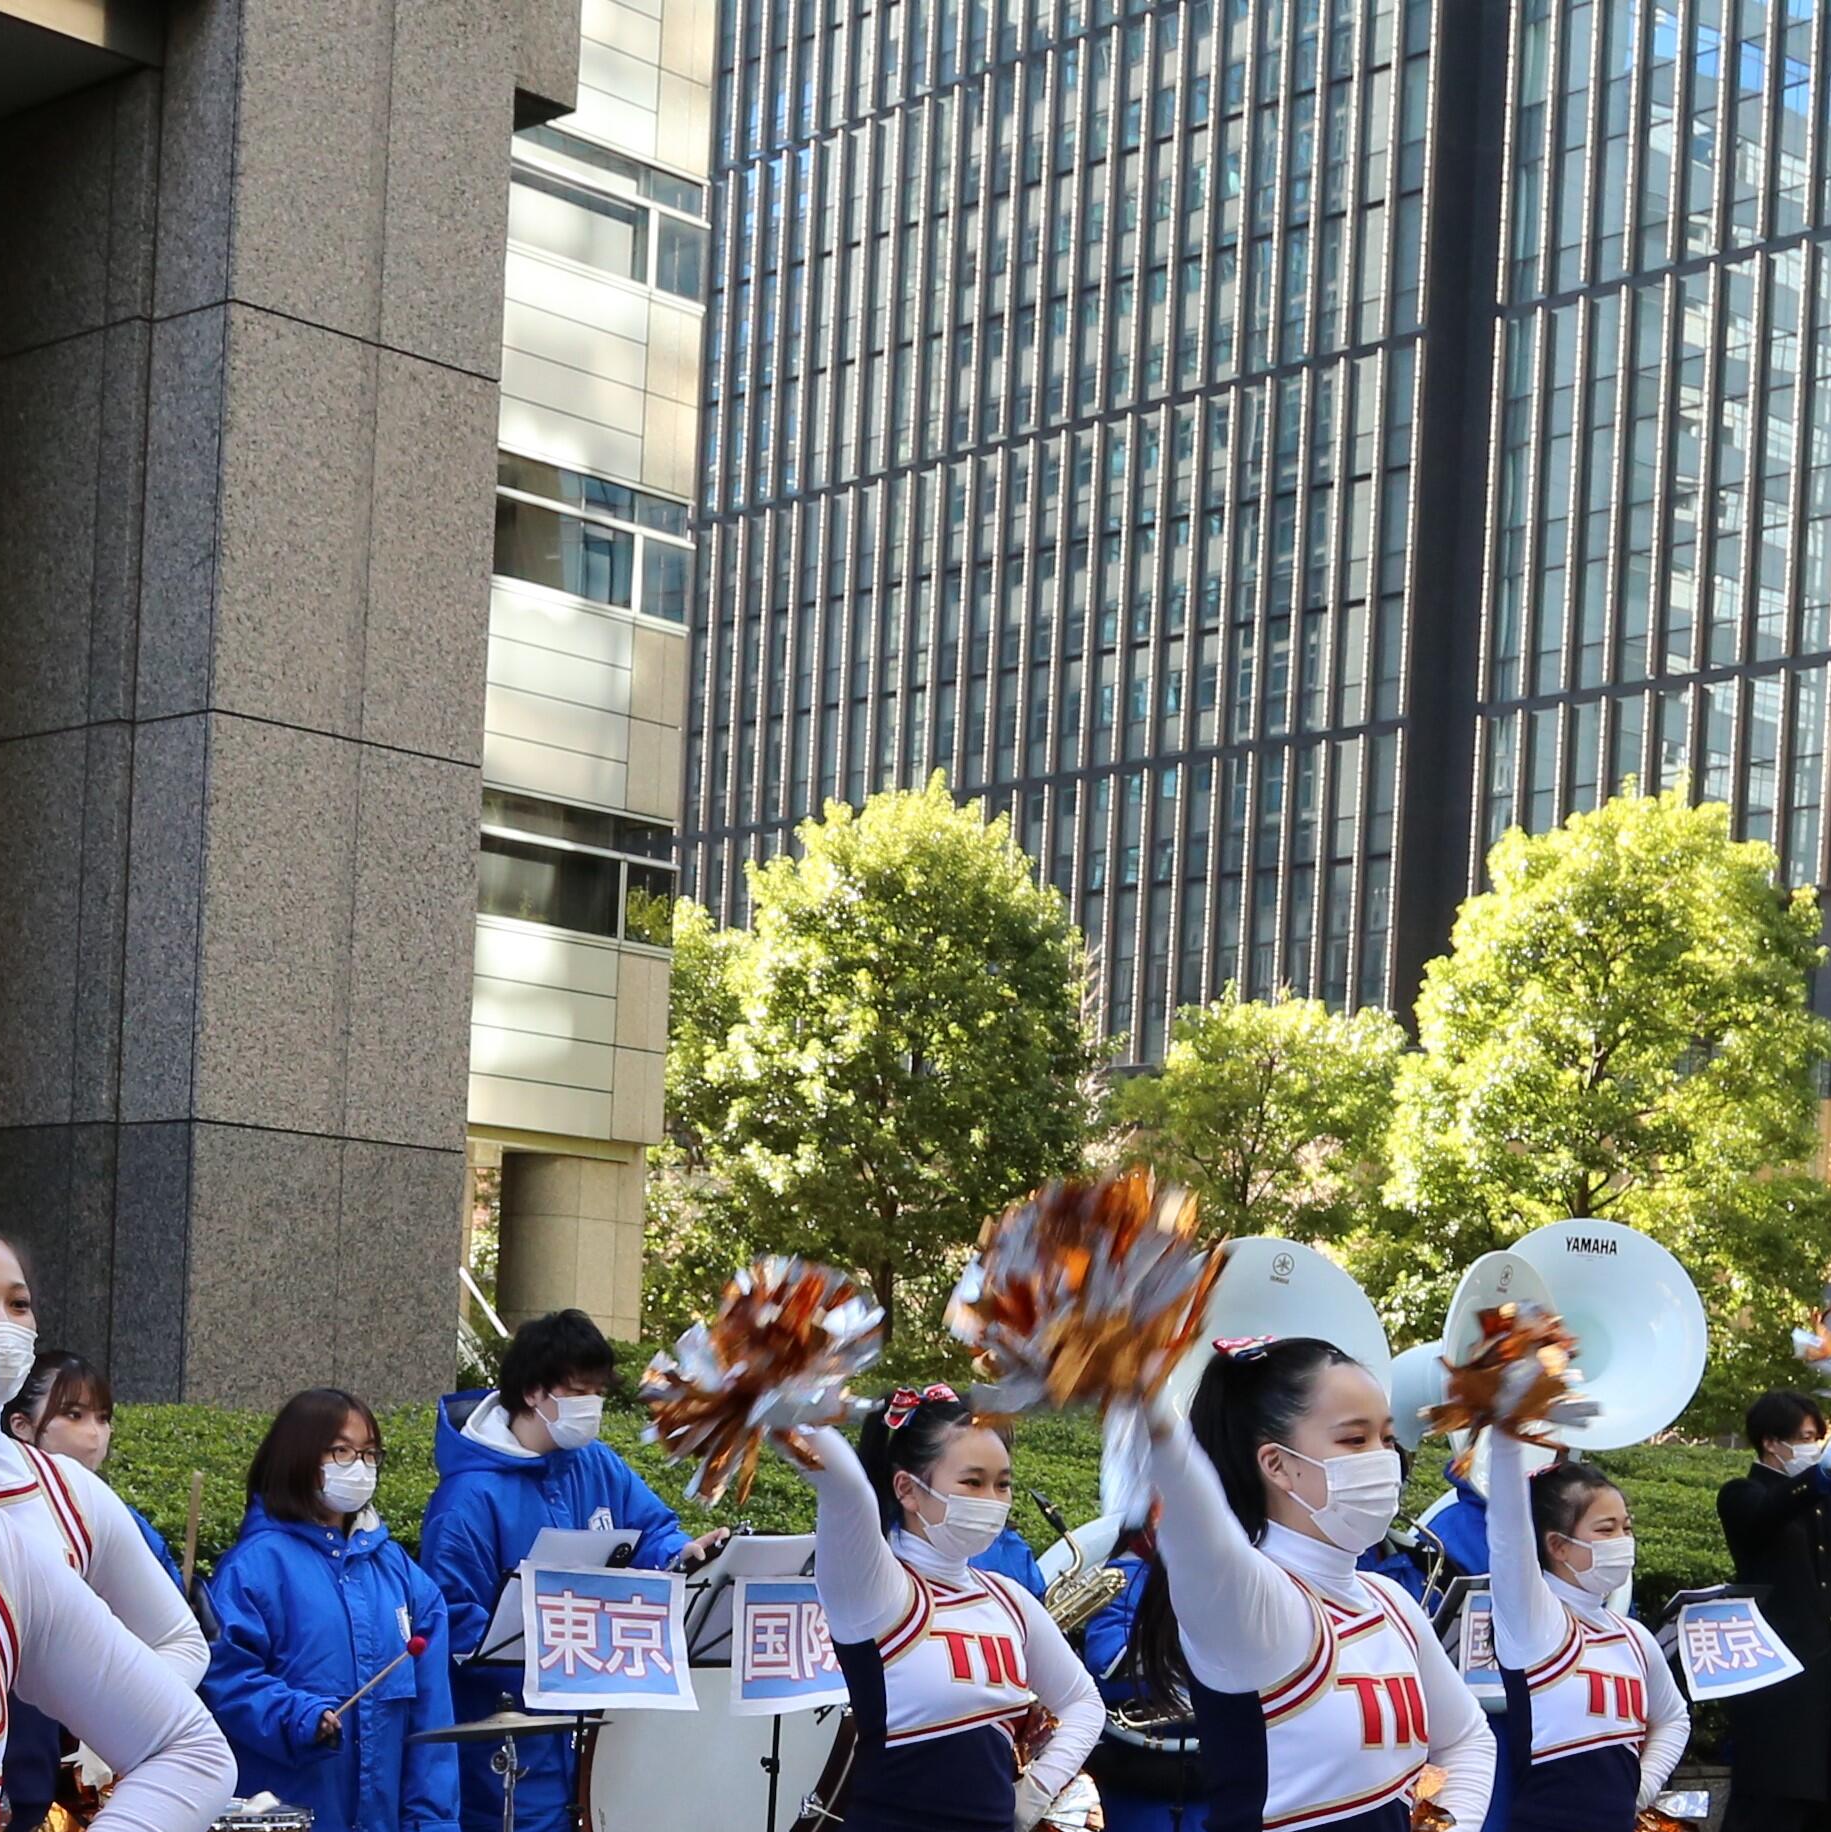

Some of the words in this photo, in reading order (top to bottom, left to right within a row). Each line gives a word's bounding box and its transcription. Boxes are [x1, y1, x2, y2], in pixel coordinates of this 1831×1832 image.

[1565, 1236, 1618, 1256] YAMAHA
[537, 1590, 675, 1681] 東京
[1684, 1613, 1774, 1675] 東京
